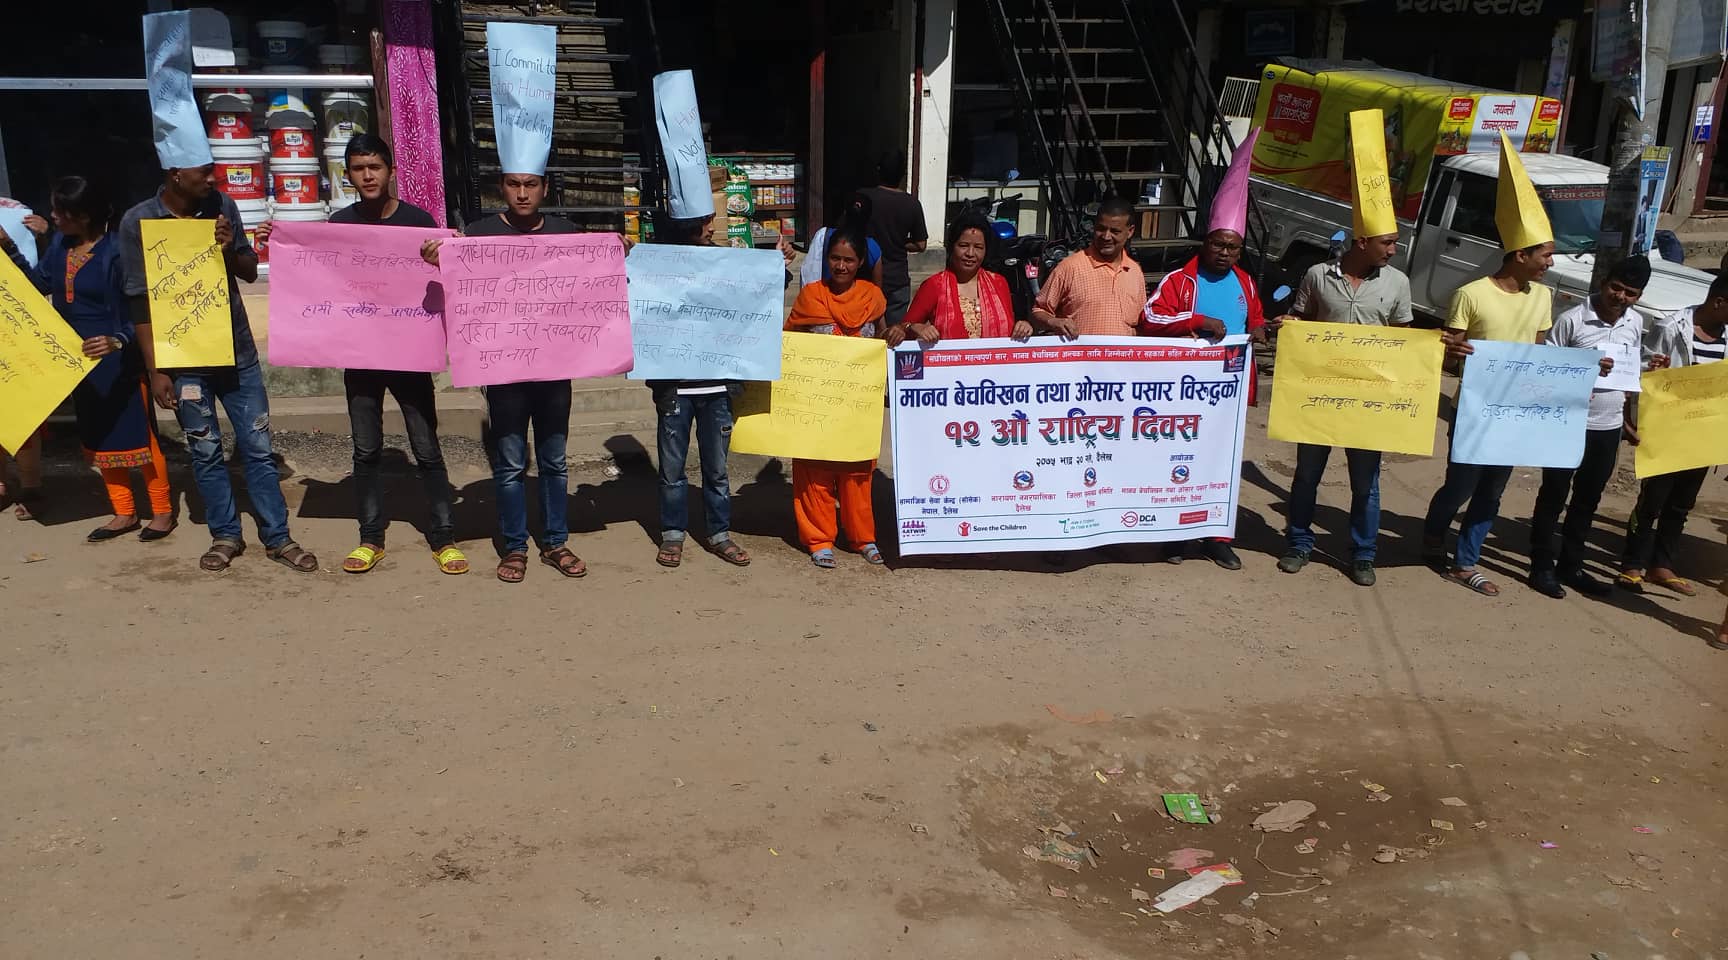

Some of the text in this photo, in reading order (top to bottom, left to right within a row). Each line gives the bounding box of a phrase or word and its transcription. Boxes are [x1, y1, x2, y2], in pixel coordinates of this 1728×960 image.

[492, 48, 556, 75] I Commit to
[899, 387, 949, 408] मानव
[1035, 382, 1071, 405] तथा
[1075, 375, 1127, 403] ओसार
[1131, 381, 1175, 403] पसार
[944, 420, 981, 448] १२
[1038, 407, 1125, 449] राष्ट्रिय
[1131, 406, 1203, 443] दिवस
[973, 522, 1027, 532] Save the Children
[1139, 514, 1157, 523] DCA
